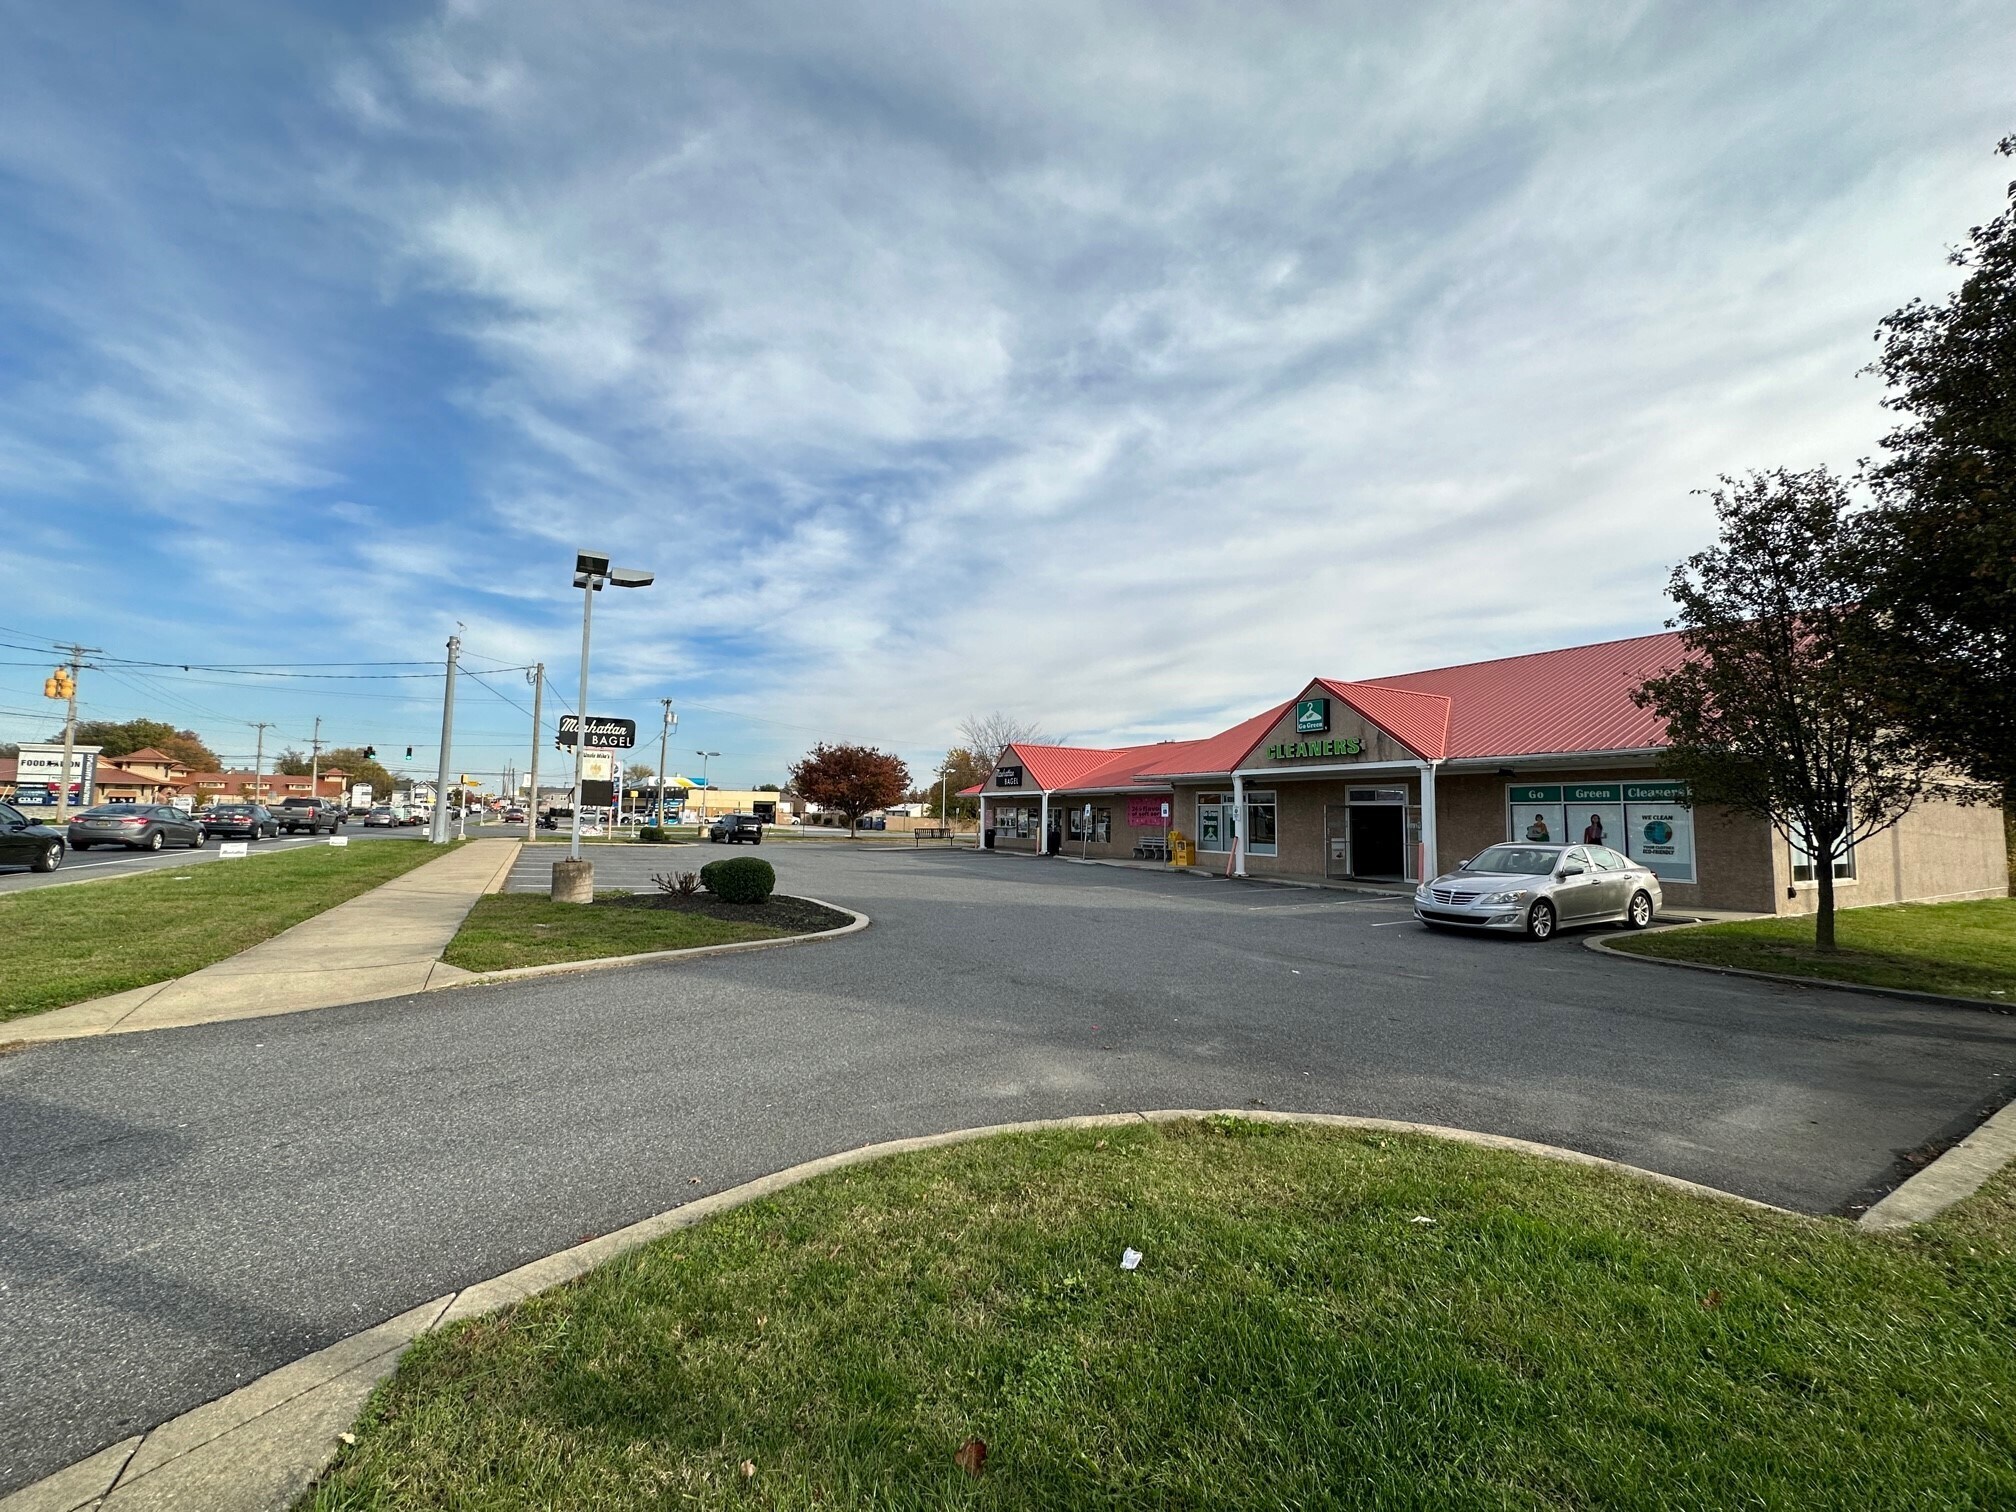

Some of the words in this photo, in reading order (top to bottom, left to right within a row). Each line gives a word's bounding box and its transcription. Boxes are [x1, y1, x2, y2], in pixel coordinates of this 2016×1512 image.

[592, 735, 632, 747] BAGEL
[1266, 737, 1360, 760] CLEANERS
[21, 759, 46, 767] FOOD
[1004, 777, 1019, 785] BAGEL
[1528, 789, 1545, 799] Go
[1575, 789, 1611, 798] Green
